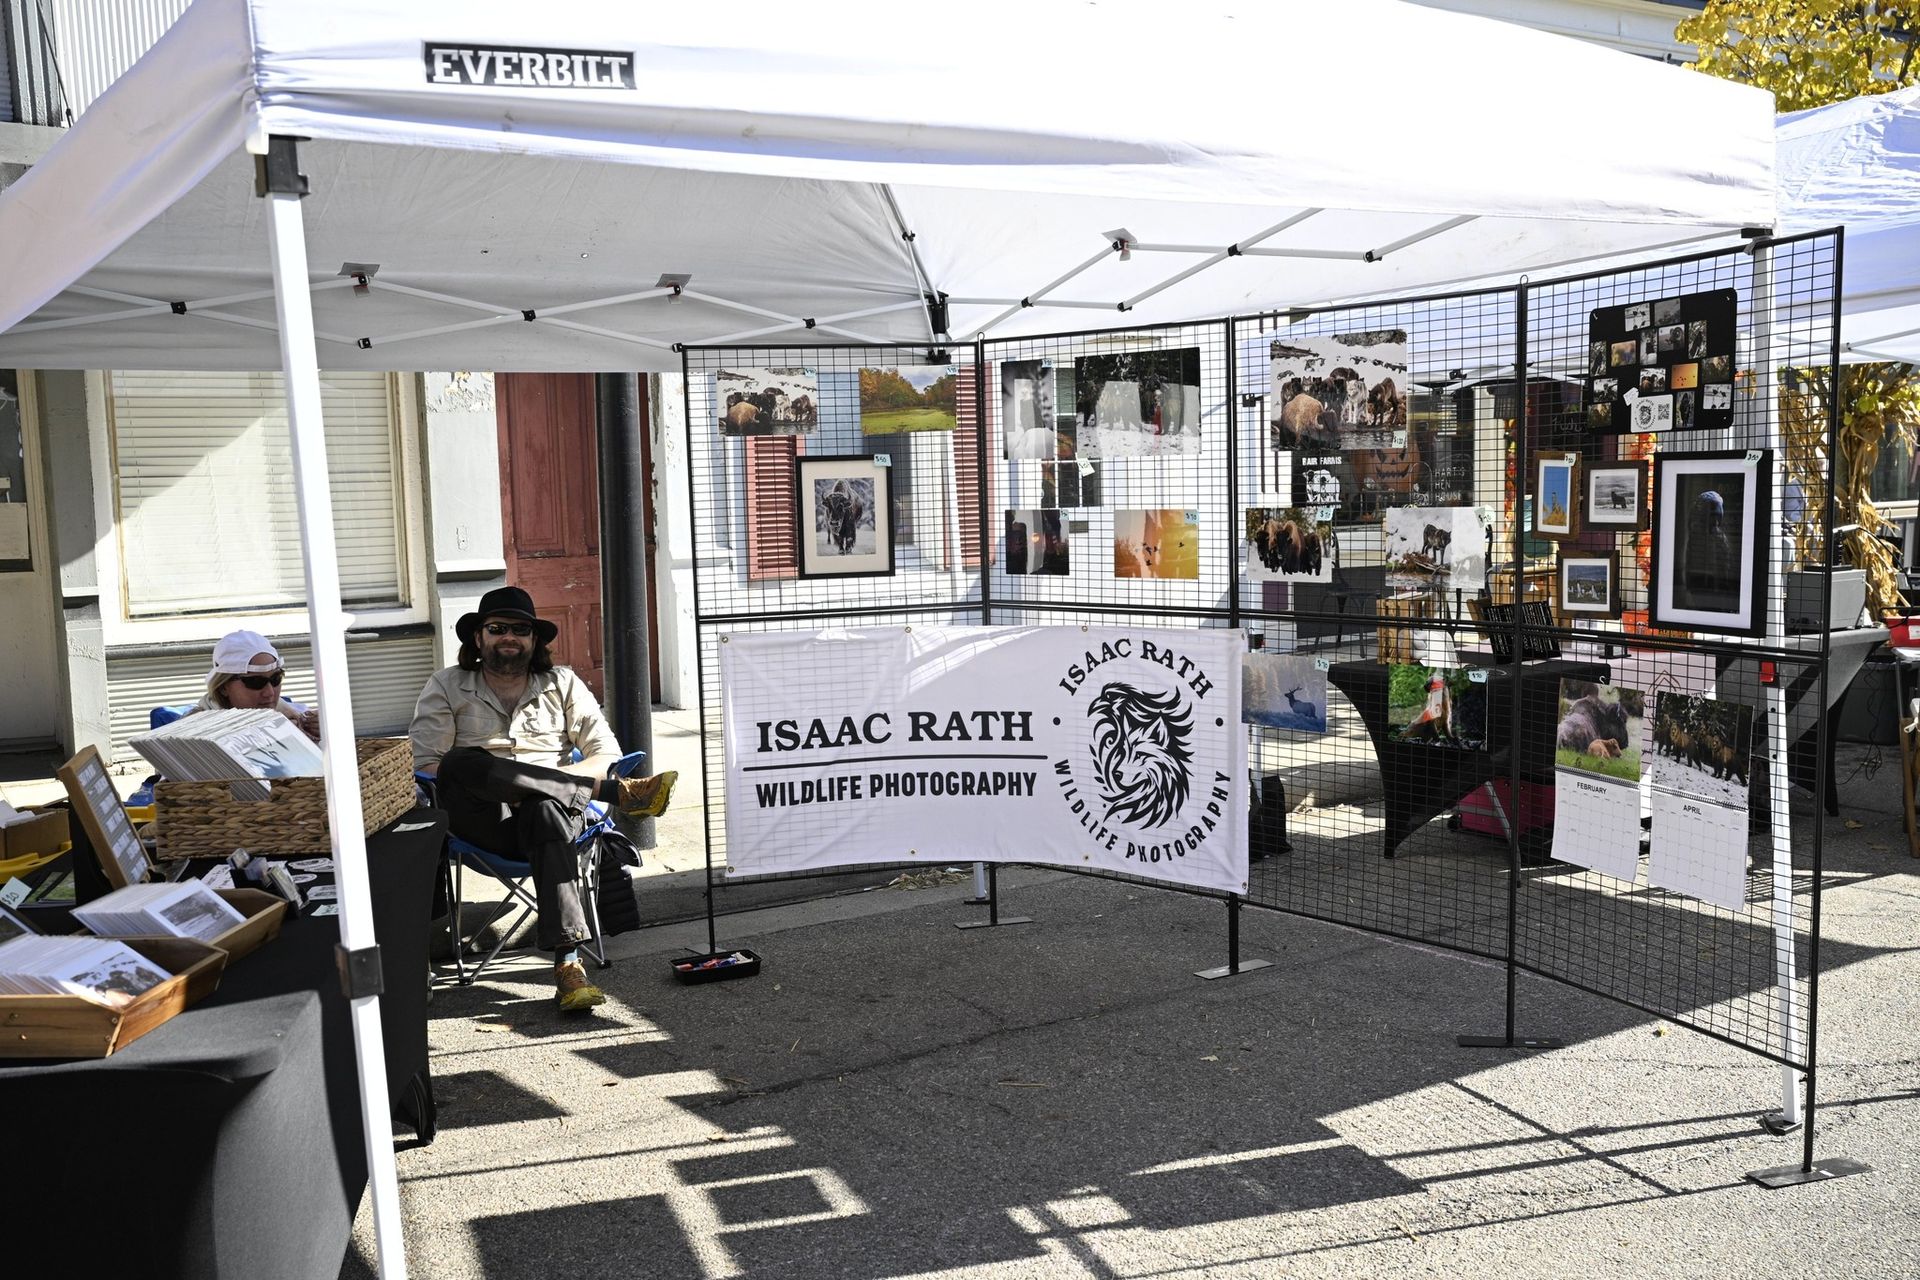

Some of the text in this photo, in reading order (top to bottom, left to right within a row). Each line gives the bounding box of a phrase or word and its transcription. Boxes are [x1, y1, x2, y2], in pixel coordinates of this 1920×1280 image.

[431, 48, 628, 88] EVERBILT
[1059, 638, 1214, 699] ISAAC RATH
[756, 711, 1033, 752] ISAAC RATH
[756, 771, 1037, 808] WILDLIFE PHOTOGRAPHY
[1576, 781, 1608, 795] FEBRUARY
[1054, 759, 1231, 863] WILDLIFE PHOTOGRAPHY
[1683, 804, 1702, 816] APRIL
